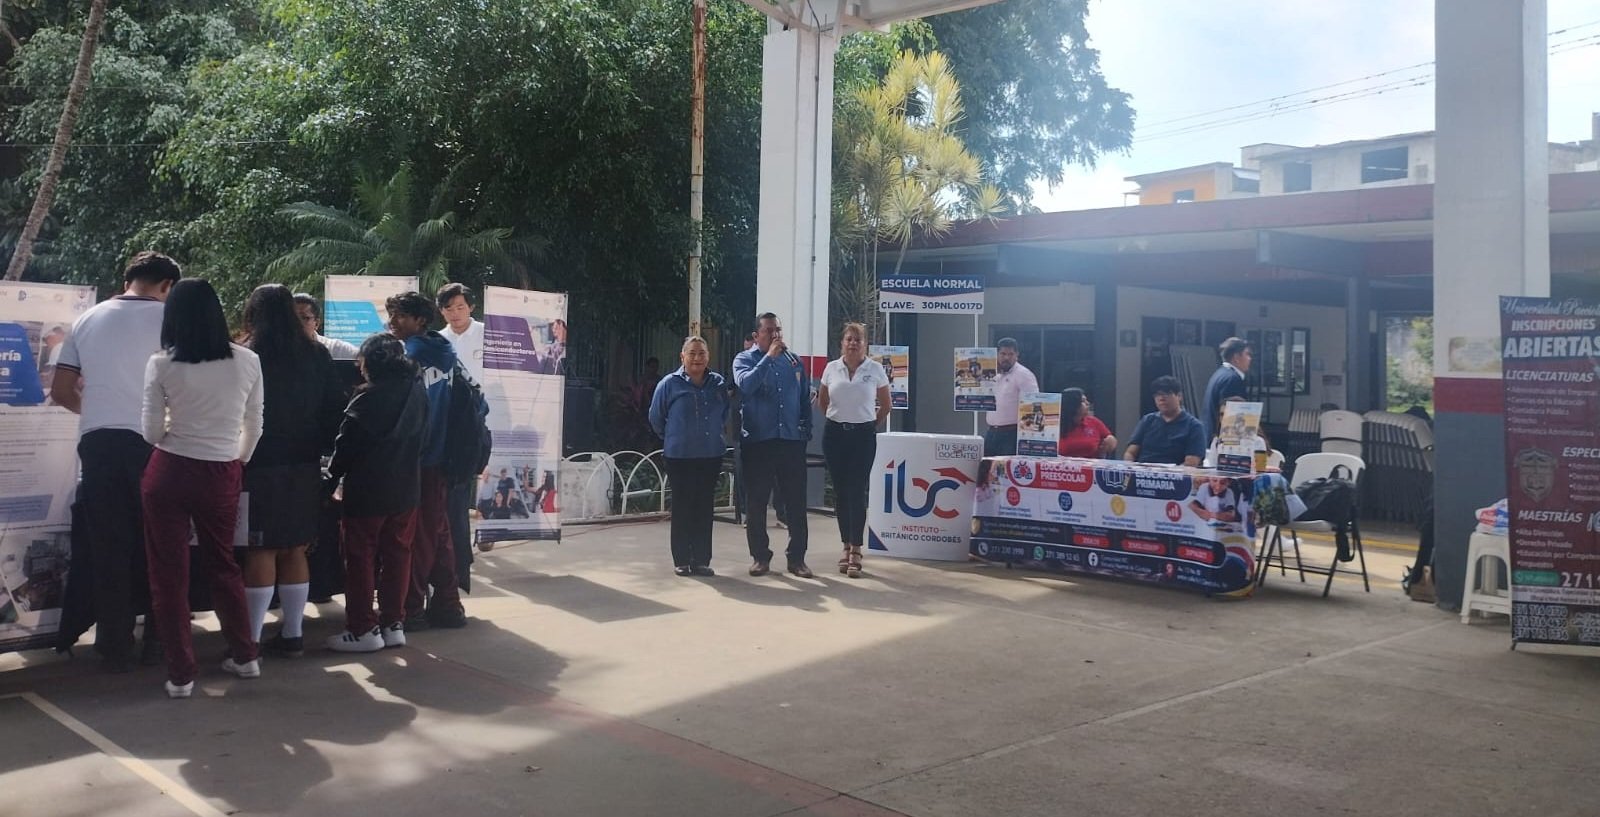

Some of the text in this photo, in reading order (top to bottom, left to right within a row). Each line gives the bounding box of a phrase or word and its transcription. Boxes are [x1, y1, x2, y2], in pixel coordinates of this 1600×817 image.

[881, 279, 981, 289] ESCUELA NORMAL
[881, 301, 983, 310] CLAVE: 30PNL0017D
[1511, 319, 1596, 332] INSCRIPCIONES
[1505, 370, 1594, 382] LICENCIATURAS
[1040, 471, 1086, 483] PREESCOLAR
[1136, 479, 1175, 490] PRIMARIA
[1518, 510, 1584, 523] MAESTRÍAS
[902, 525, 939, 533] INSTITUTO
